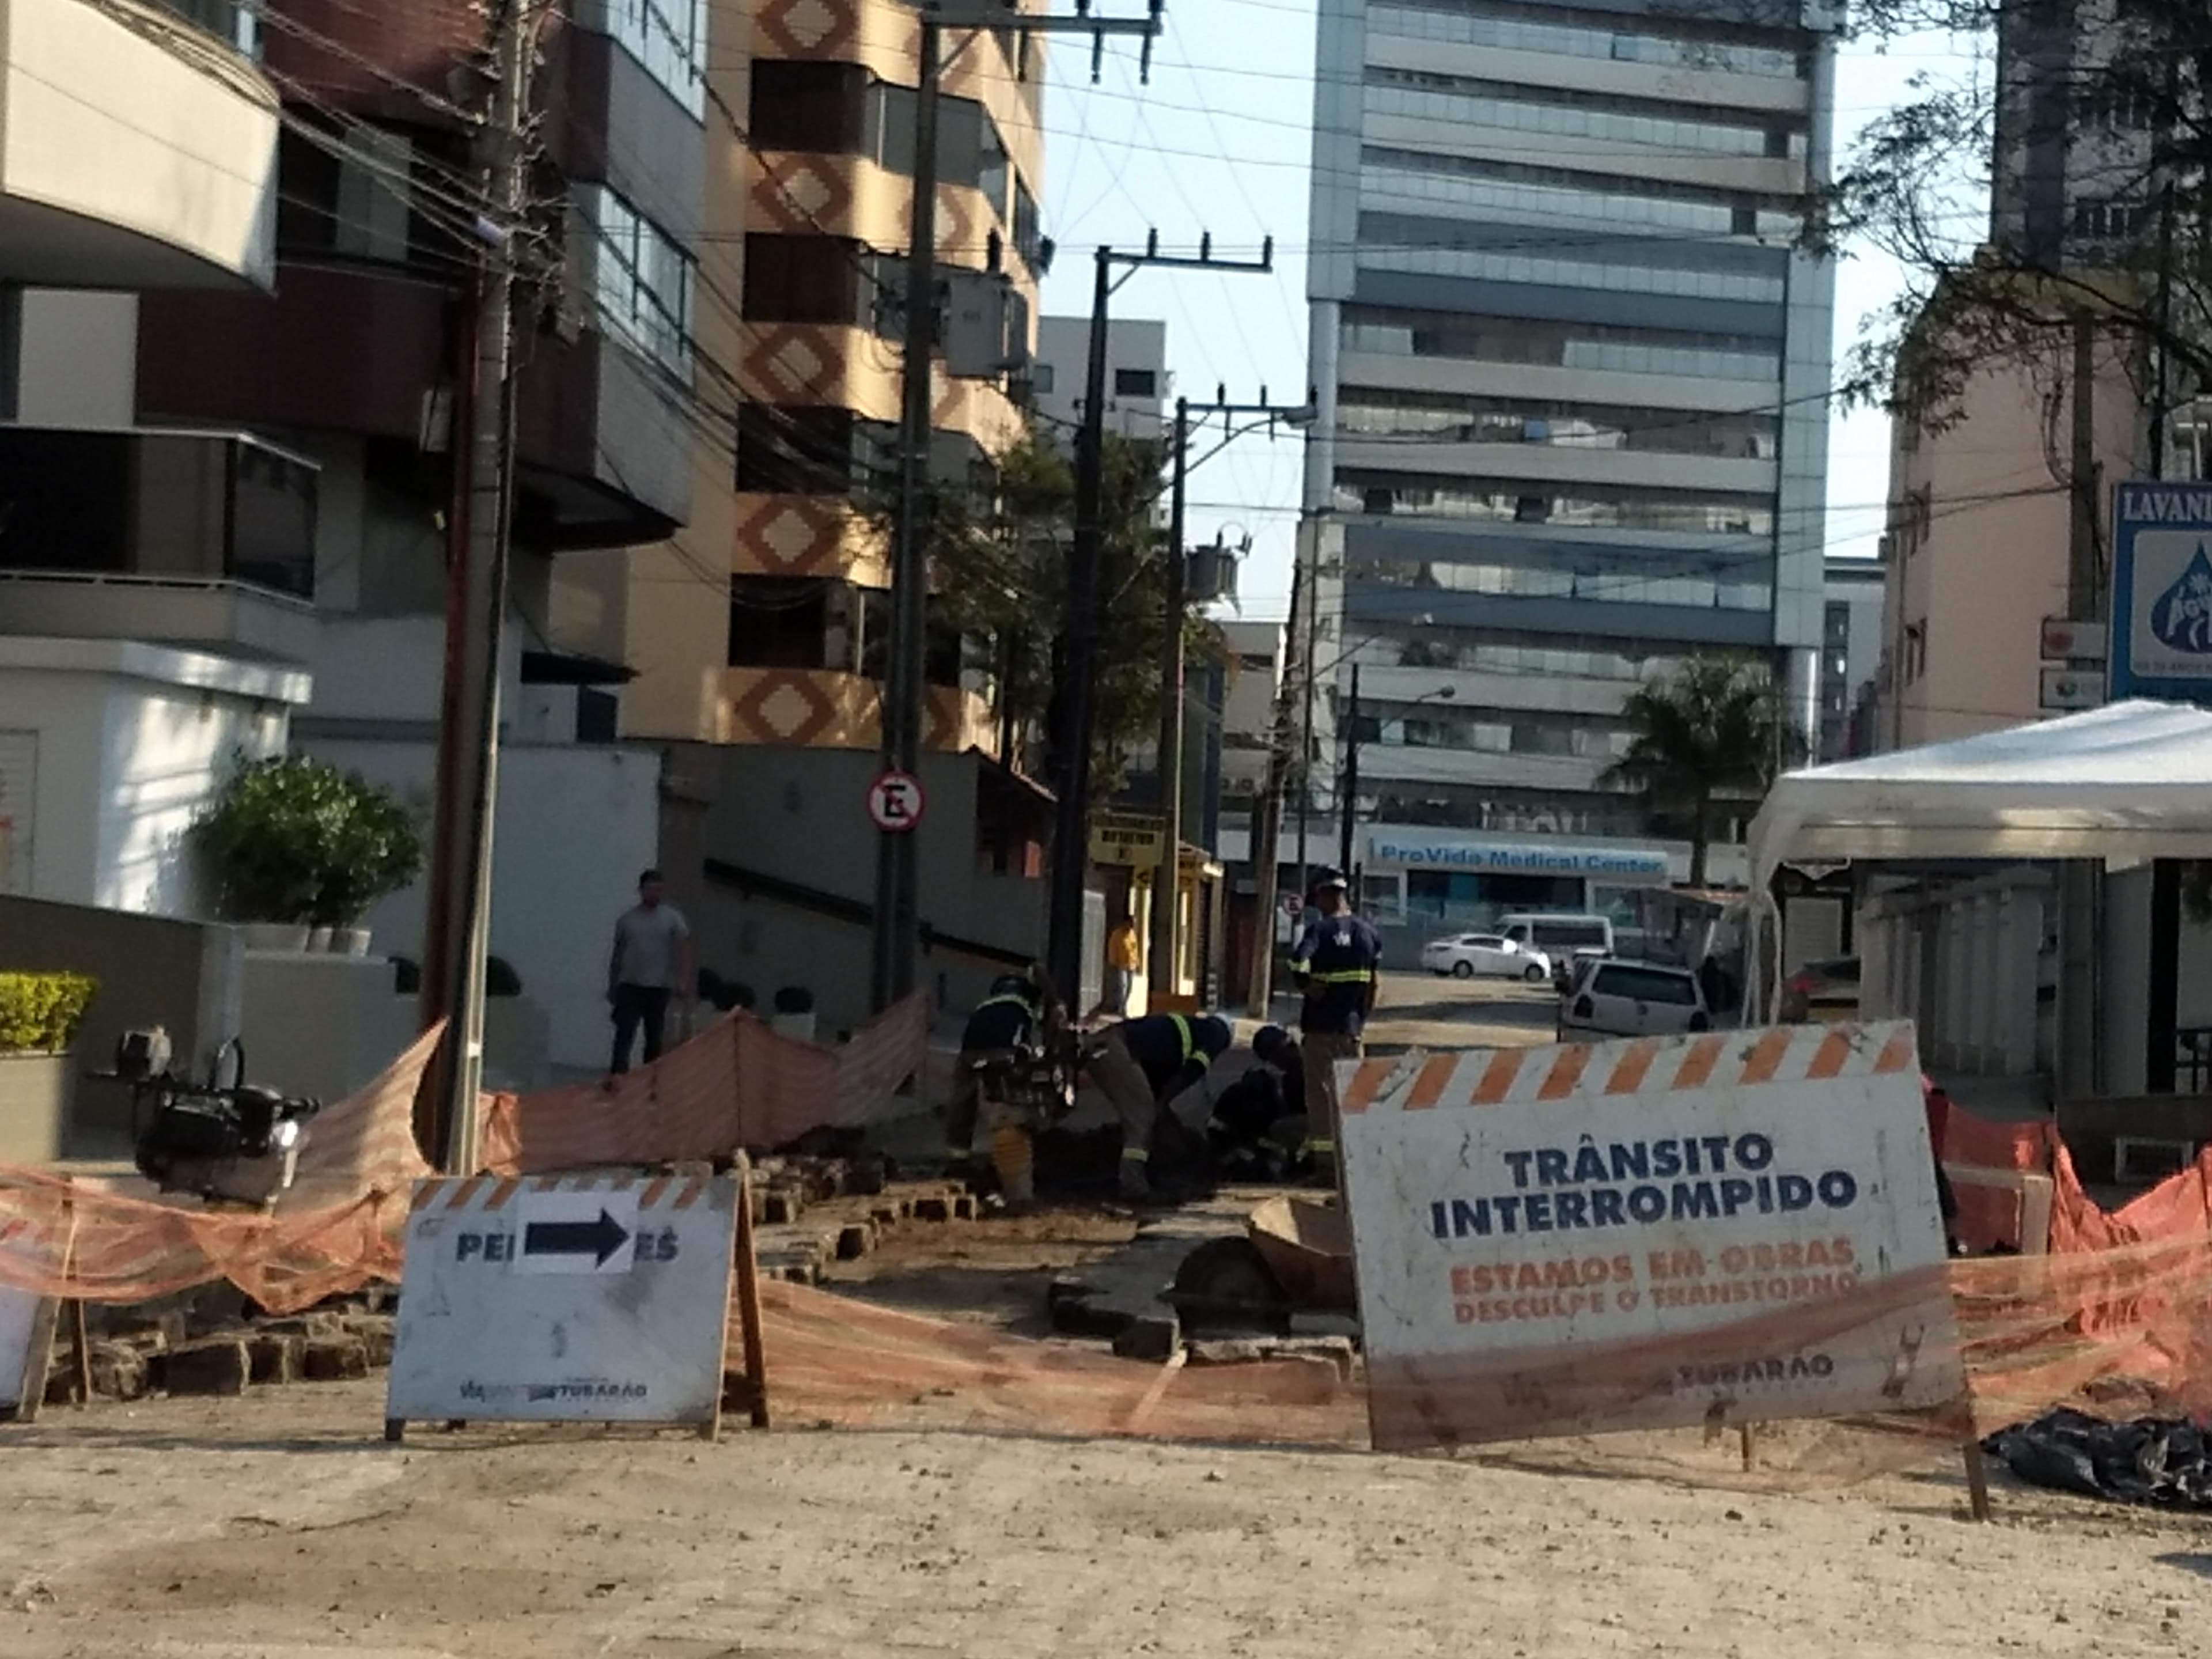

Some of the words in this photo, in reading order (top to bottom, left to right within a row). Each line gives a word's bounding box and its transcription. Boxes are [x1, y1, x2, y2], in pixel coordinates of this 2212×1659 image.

[1381, 845, 1482, 865] ProVida
[1490, 851, 1577, 869] Medical
[1586, 855, 1662, 873] Center
[1504, 1132, 1774, 1189] TRÂNSITO
[1430, 1169, 1858, 1239] INTERROMPIDO
[1450, 1254, 1633, 1296] ESTAMOS
[1648, 1248, 1706, 1280] EM
[1719, 1237, 1855, 1275] OBRAS
[1454, 1291, 1605, 1324] DESCULPE
[1616, 1289, 1640, 1313] O
[1649, 1271, 1858, 1309] TRANSTORNO
